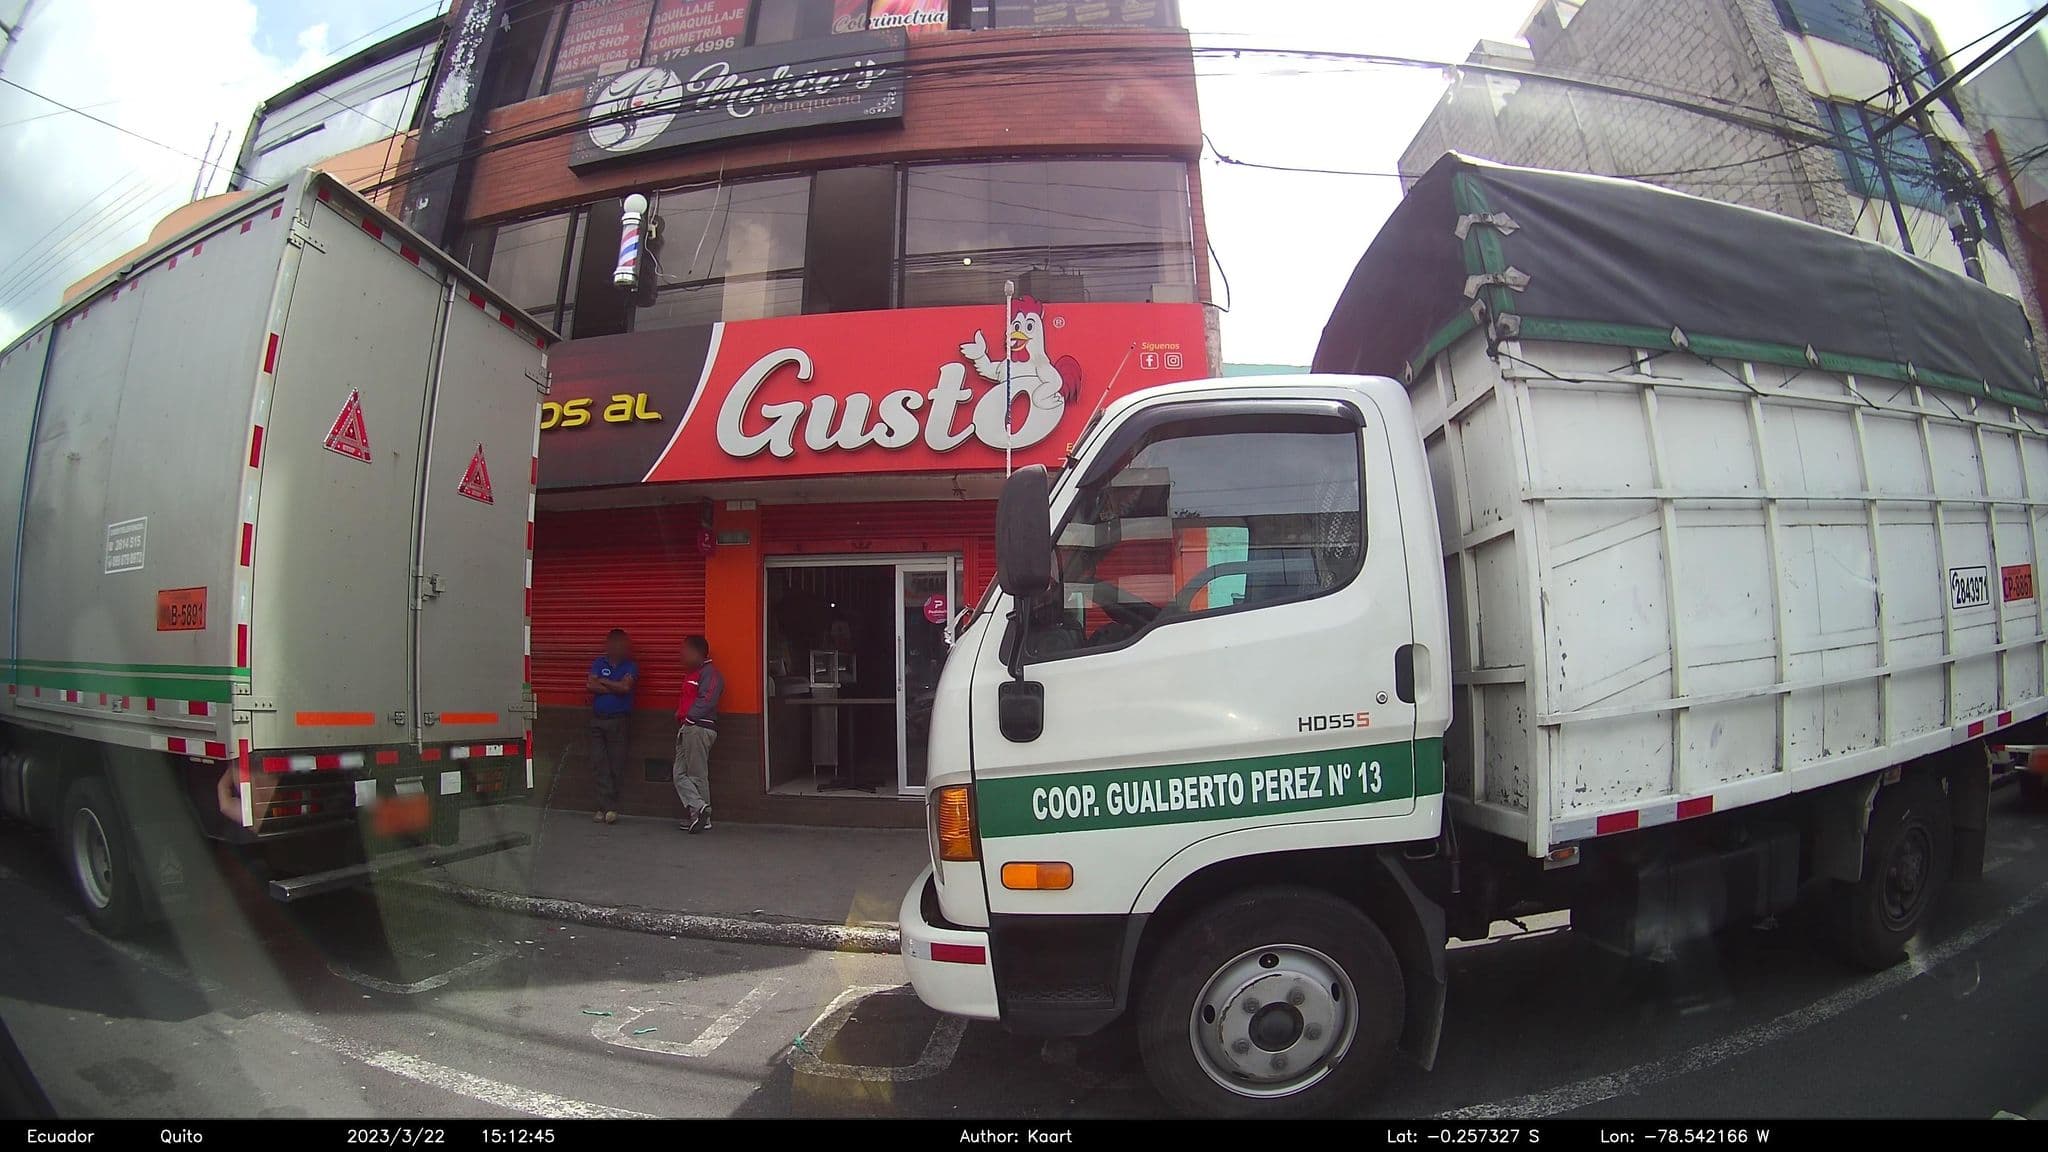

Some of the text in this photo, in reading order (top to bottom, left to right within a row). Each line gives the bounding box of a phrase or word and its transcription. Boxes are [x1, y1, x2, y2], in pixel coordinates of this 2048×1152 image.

[558, 35, 630, 60] ARBER SHOP
[694, 36, 736, 54] 4996
[716, 347, 1065, 458] Gusto
[1032, 784, 1100, 820] COOP.
[1106, 772, 1244, 816] GUALBERTO
[1251, 765, 1323, 803] PEREZ
[1358, 760, 1382, 794] 13
